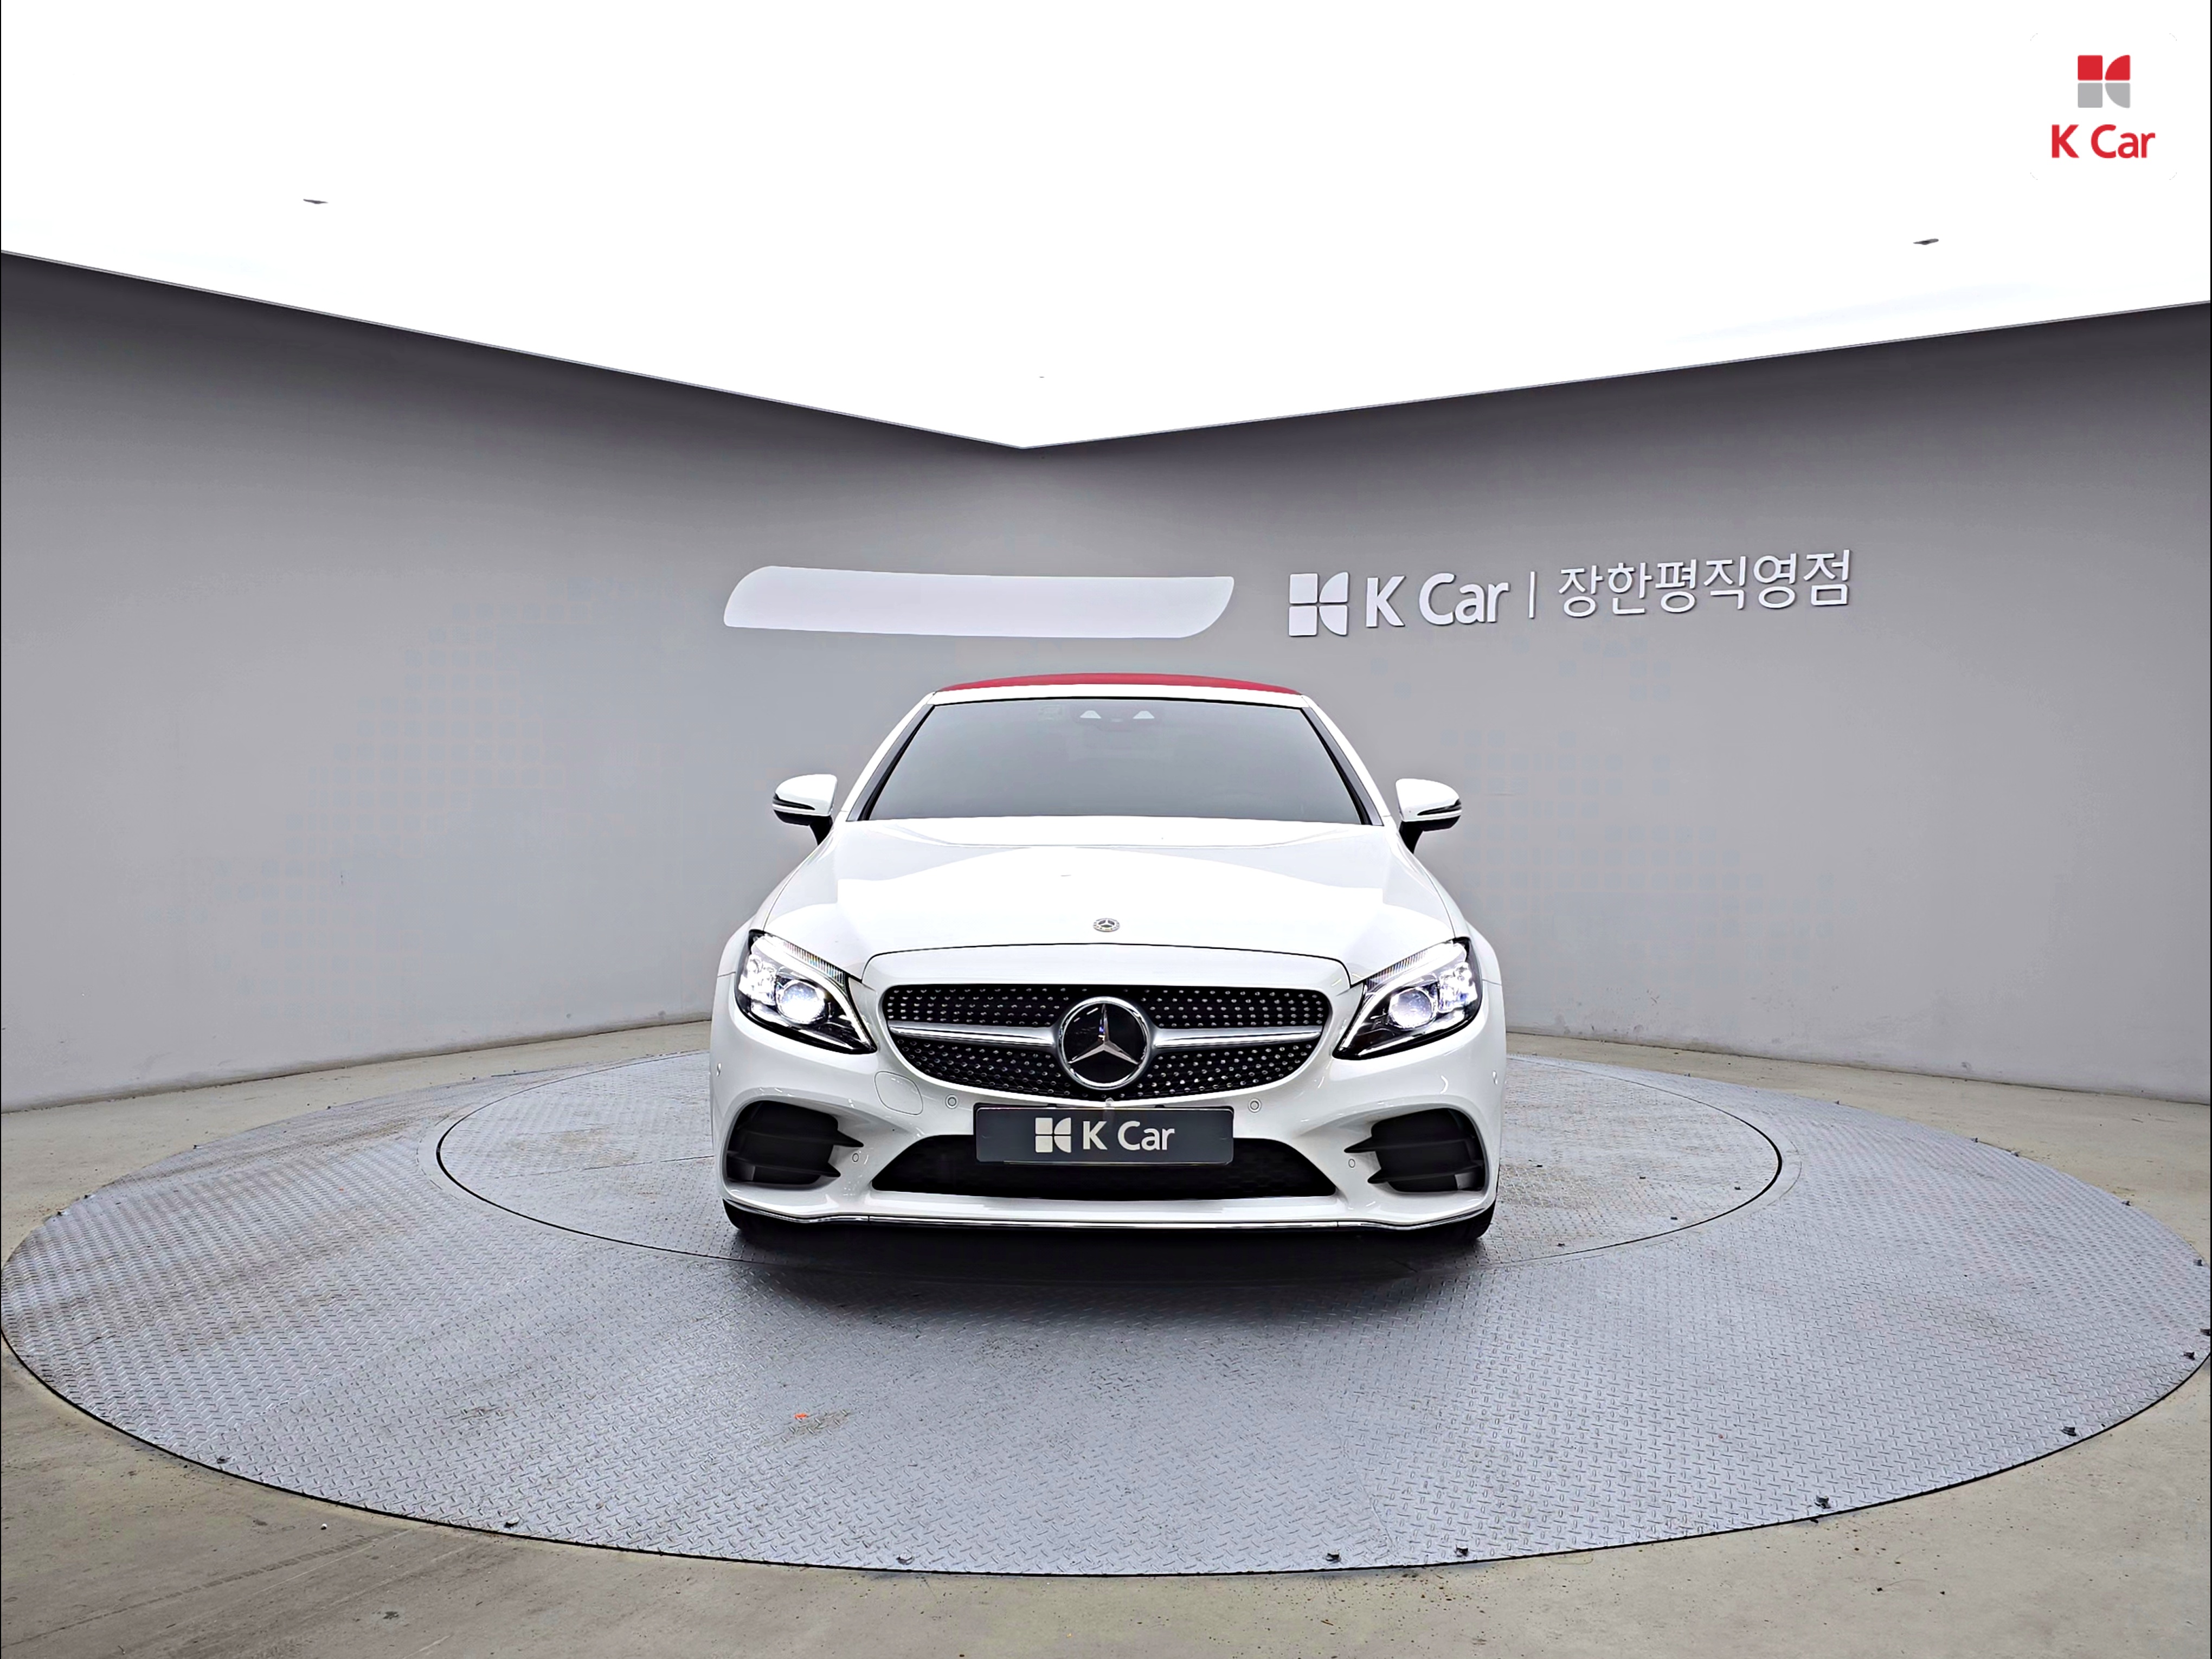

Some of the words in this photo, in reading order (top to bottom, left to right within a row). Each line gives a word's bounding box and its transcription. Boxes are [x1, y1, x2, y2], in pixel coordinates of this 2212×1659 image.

[1366, 575, 1405, 627] K
[1419, 573, 1510, 626] Car
[1559, 549, 1850, 618] 장한평직영점
[1083, 1121, 1108, 1150] K
[1117, 1121, 1175, 1151] Car
